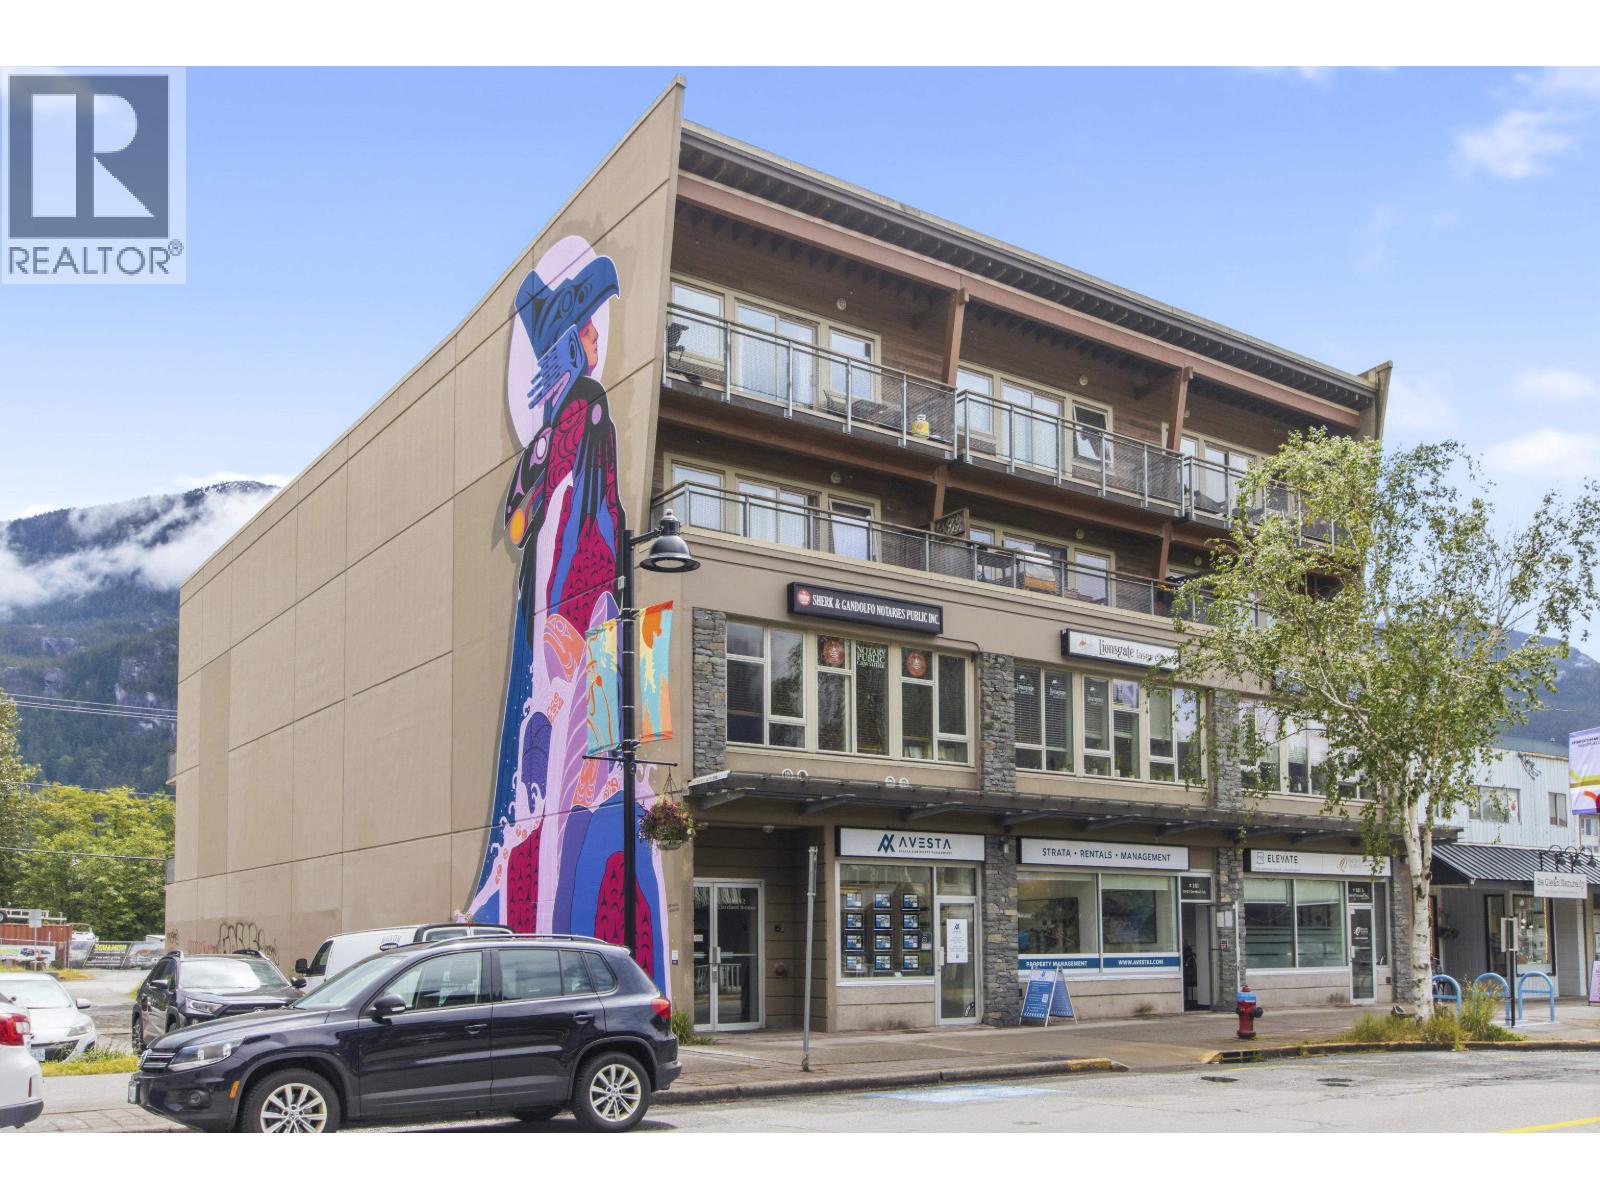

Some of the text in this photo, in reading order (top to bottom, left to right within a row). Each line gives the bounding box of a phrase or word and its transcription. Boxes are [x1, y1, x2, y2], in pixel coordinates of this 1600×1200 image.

[812, 594, 940, 625] SHERK & GANDOLFO NOTARIES PUBLIC INC.
[857, 645, 886, 656] NOTARY
[1099, 639, 1134, 658] Lionsgate
[857, 653, 886, 663] PUBLIC
[899, 836, 952, 850] AVESTA
[1042, 847, 1171, 862] STRATA RENTALS MANAGEMENT
[1267, 854, 1298, 864] ELEVATE
